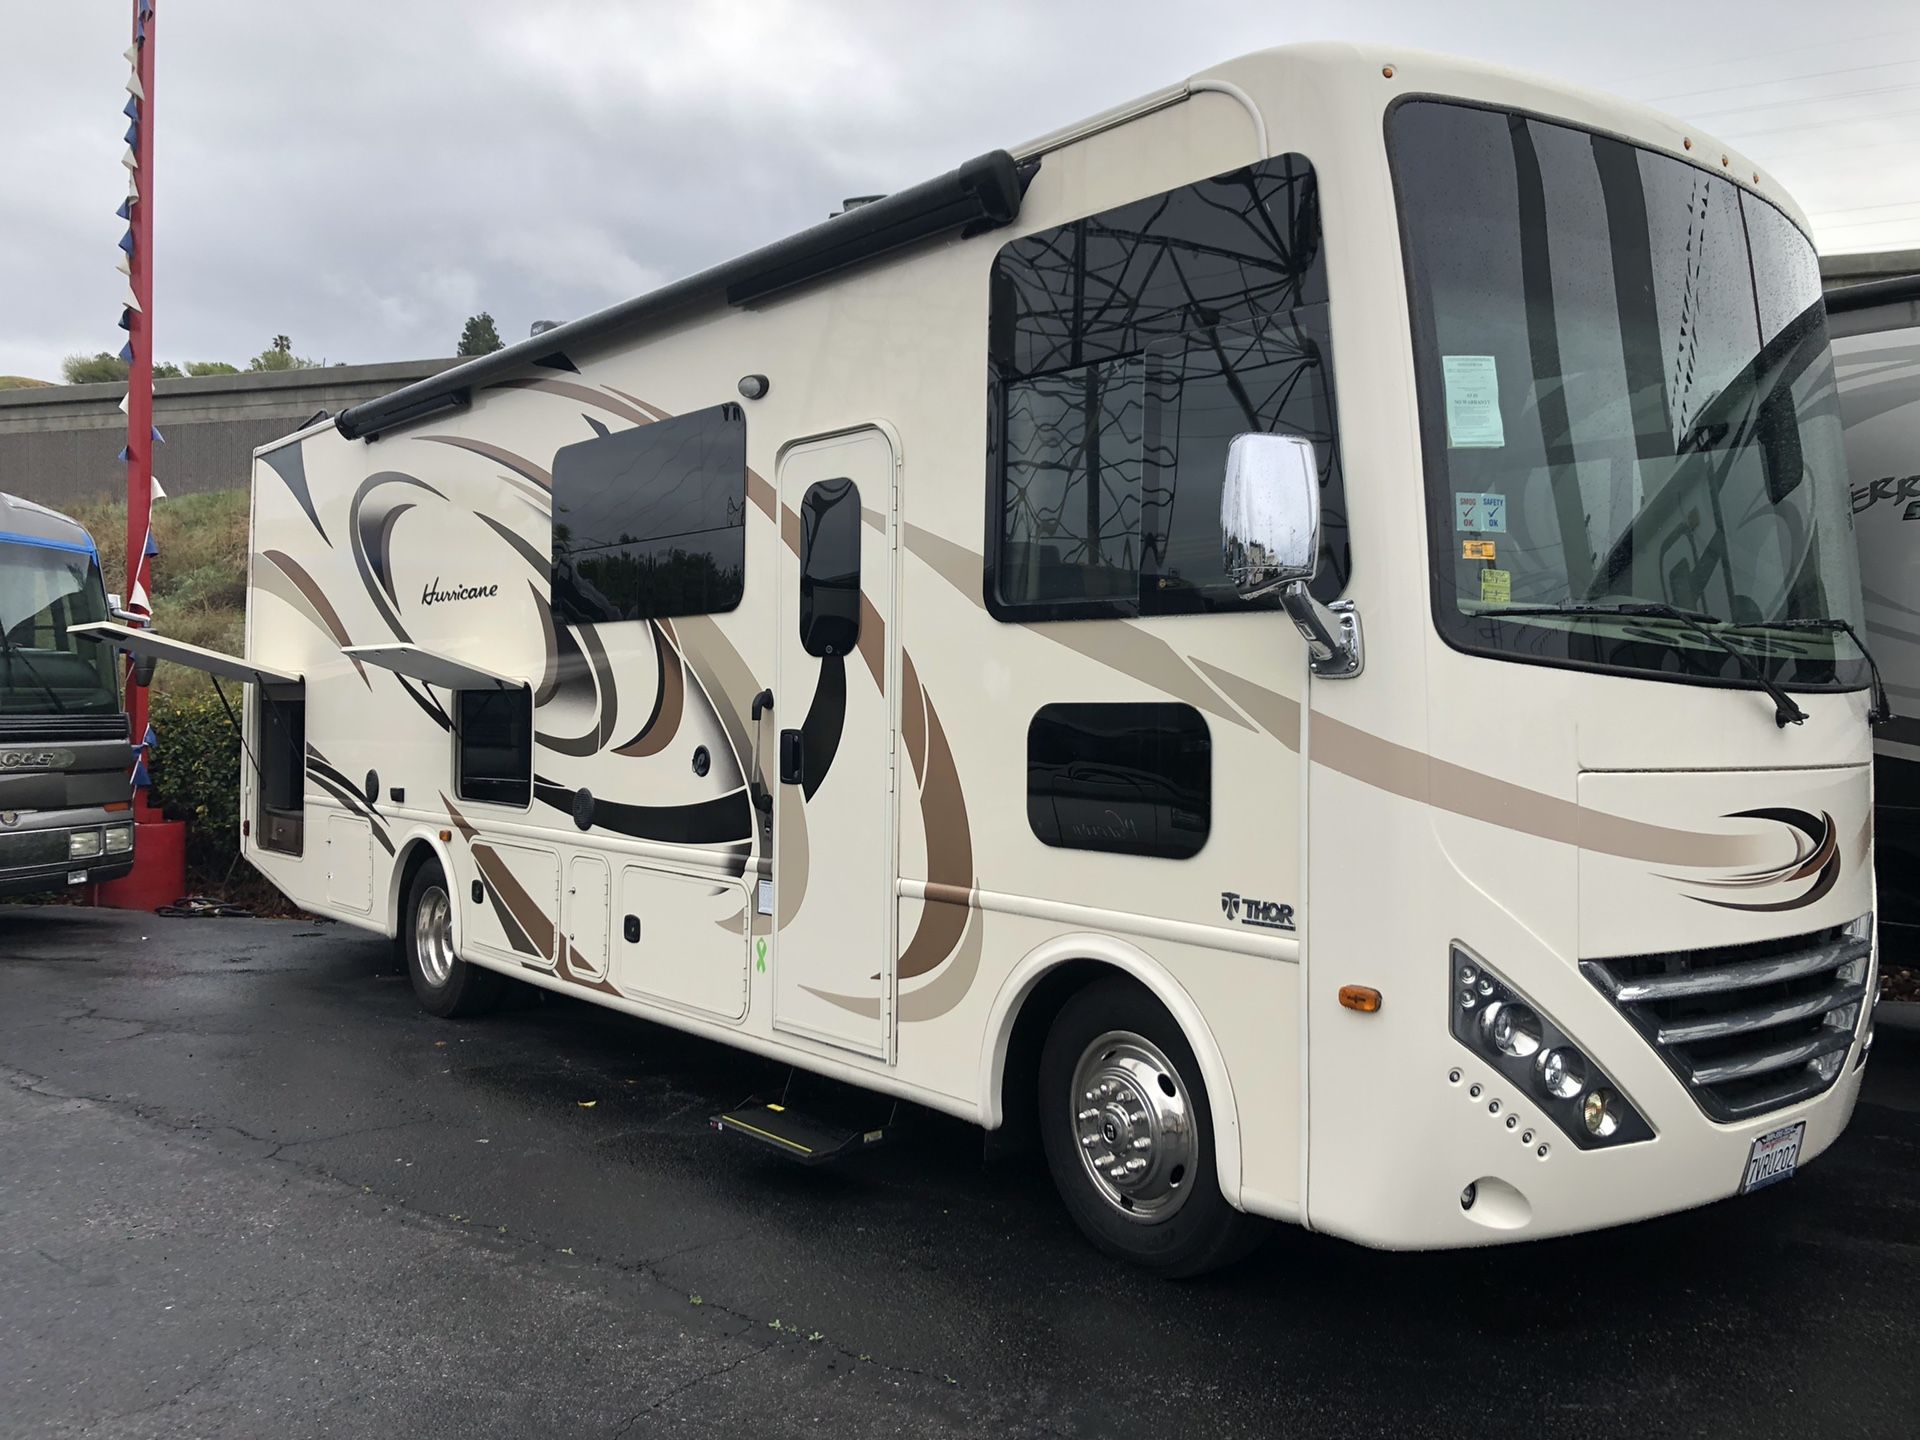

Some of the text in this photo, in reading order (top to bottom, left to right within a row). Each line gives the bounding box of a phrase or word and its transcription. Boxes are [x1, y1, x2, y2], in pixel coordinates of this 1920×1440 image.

[1460, 498, 1476, 506] SMOG
[1483, 498, 1503, 507] SAFETY
[1464, 519, 1473, 527] OK
[1489, 519, 1498, 527] OK
[421, 576, 498, 605] Hurricane
[1242, 898, 1294, 925] THOR
[1749, 1144, 1796, 1183] 7VRU202
